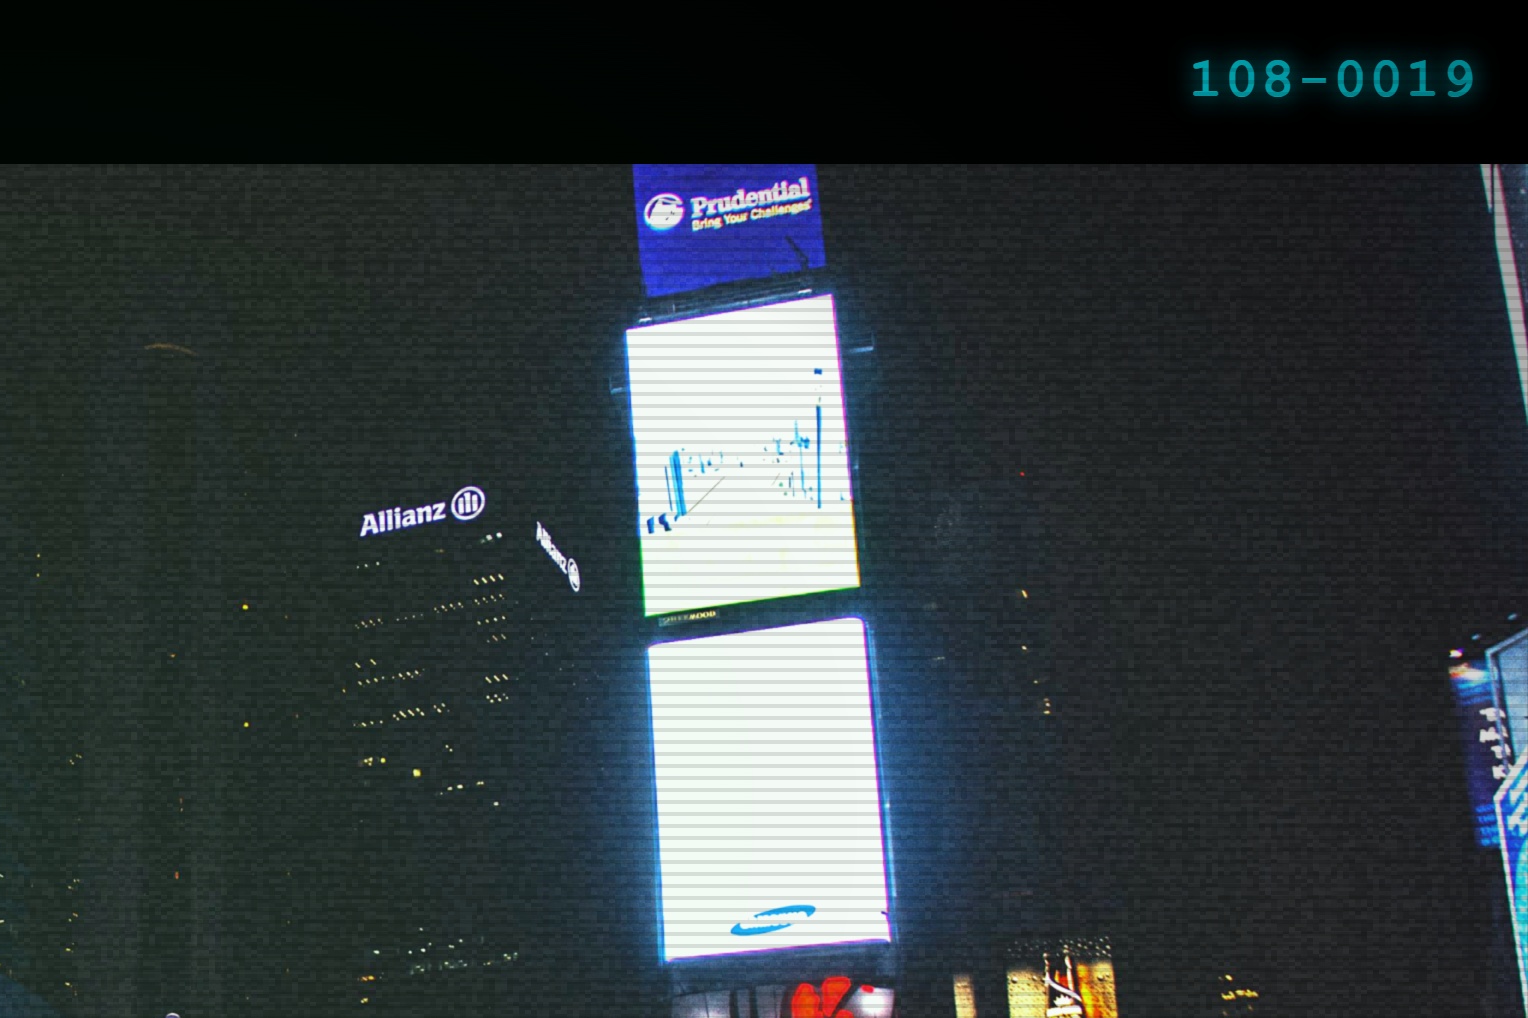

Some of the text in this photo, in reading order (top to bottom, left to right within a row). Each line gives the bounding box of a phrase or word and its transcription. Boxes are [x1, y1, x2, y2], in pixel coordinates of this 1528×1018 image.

[690, 176, 812, 219] Prudential
[691, 217, 723, 232] Bring
[723, 212, 750, 225] Your
[359, 502, 447, 537] Allianz
